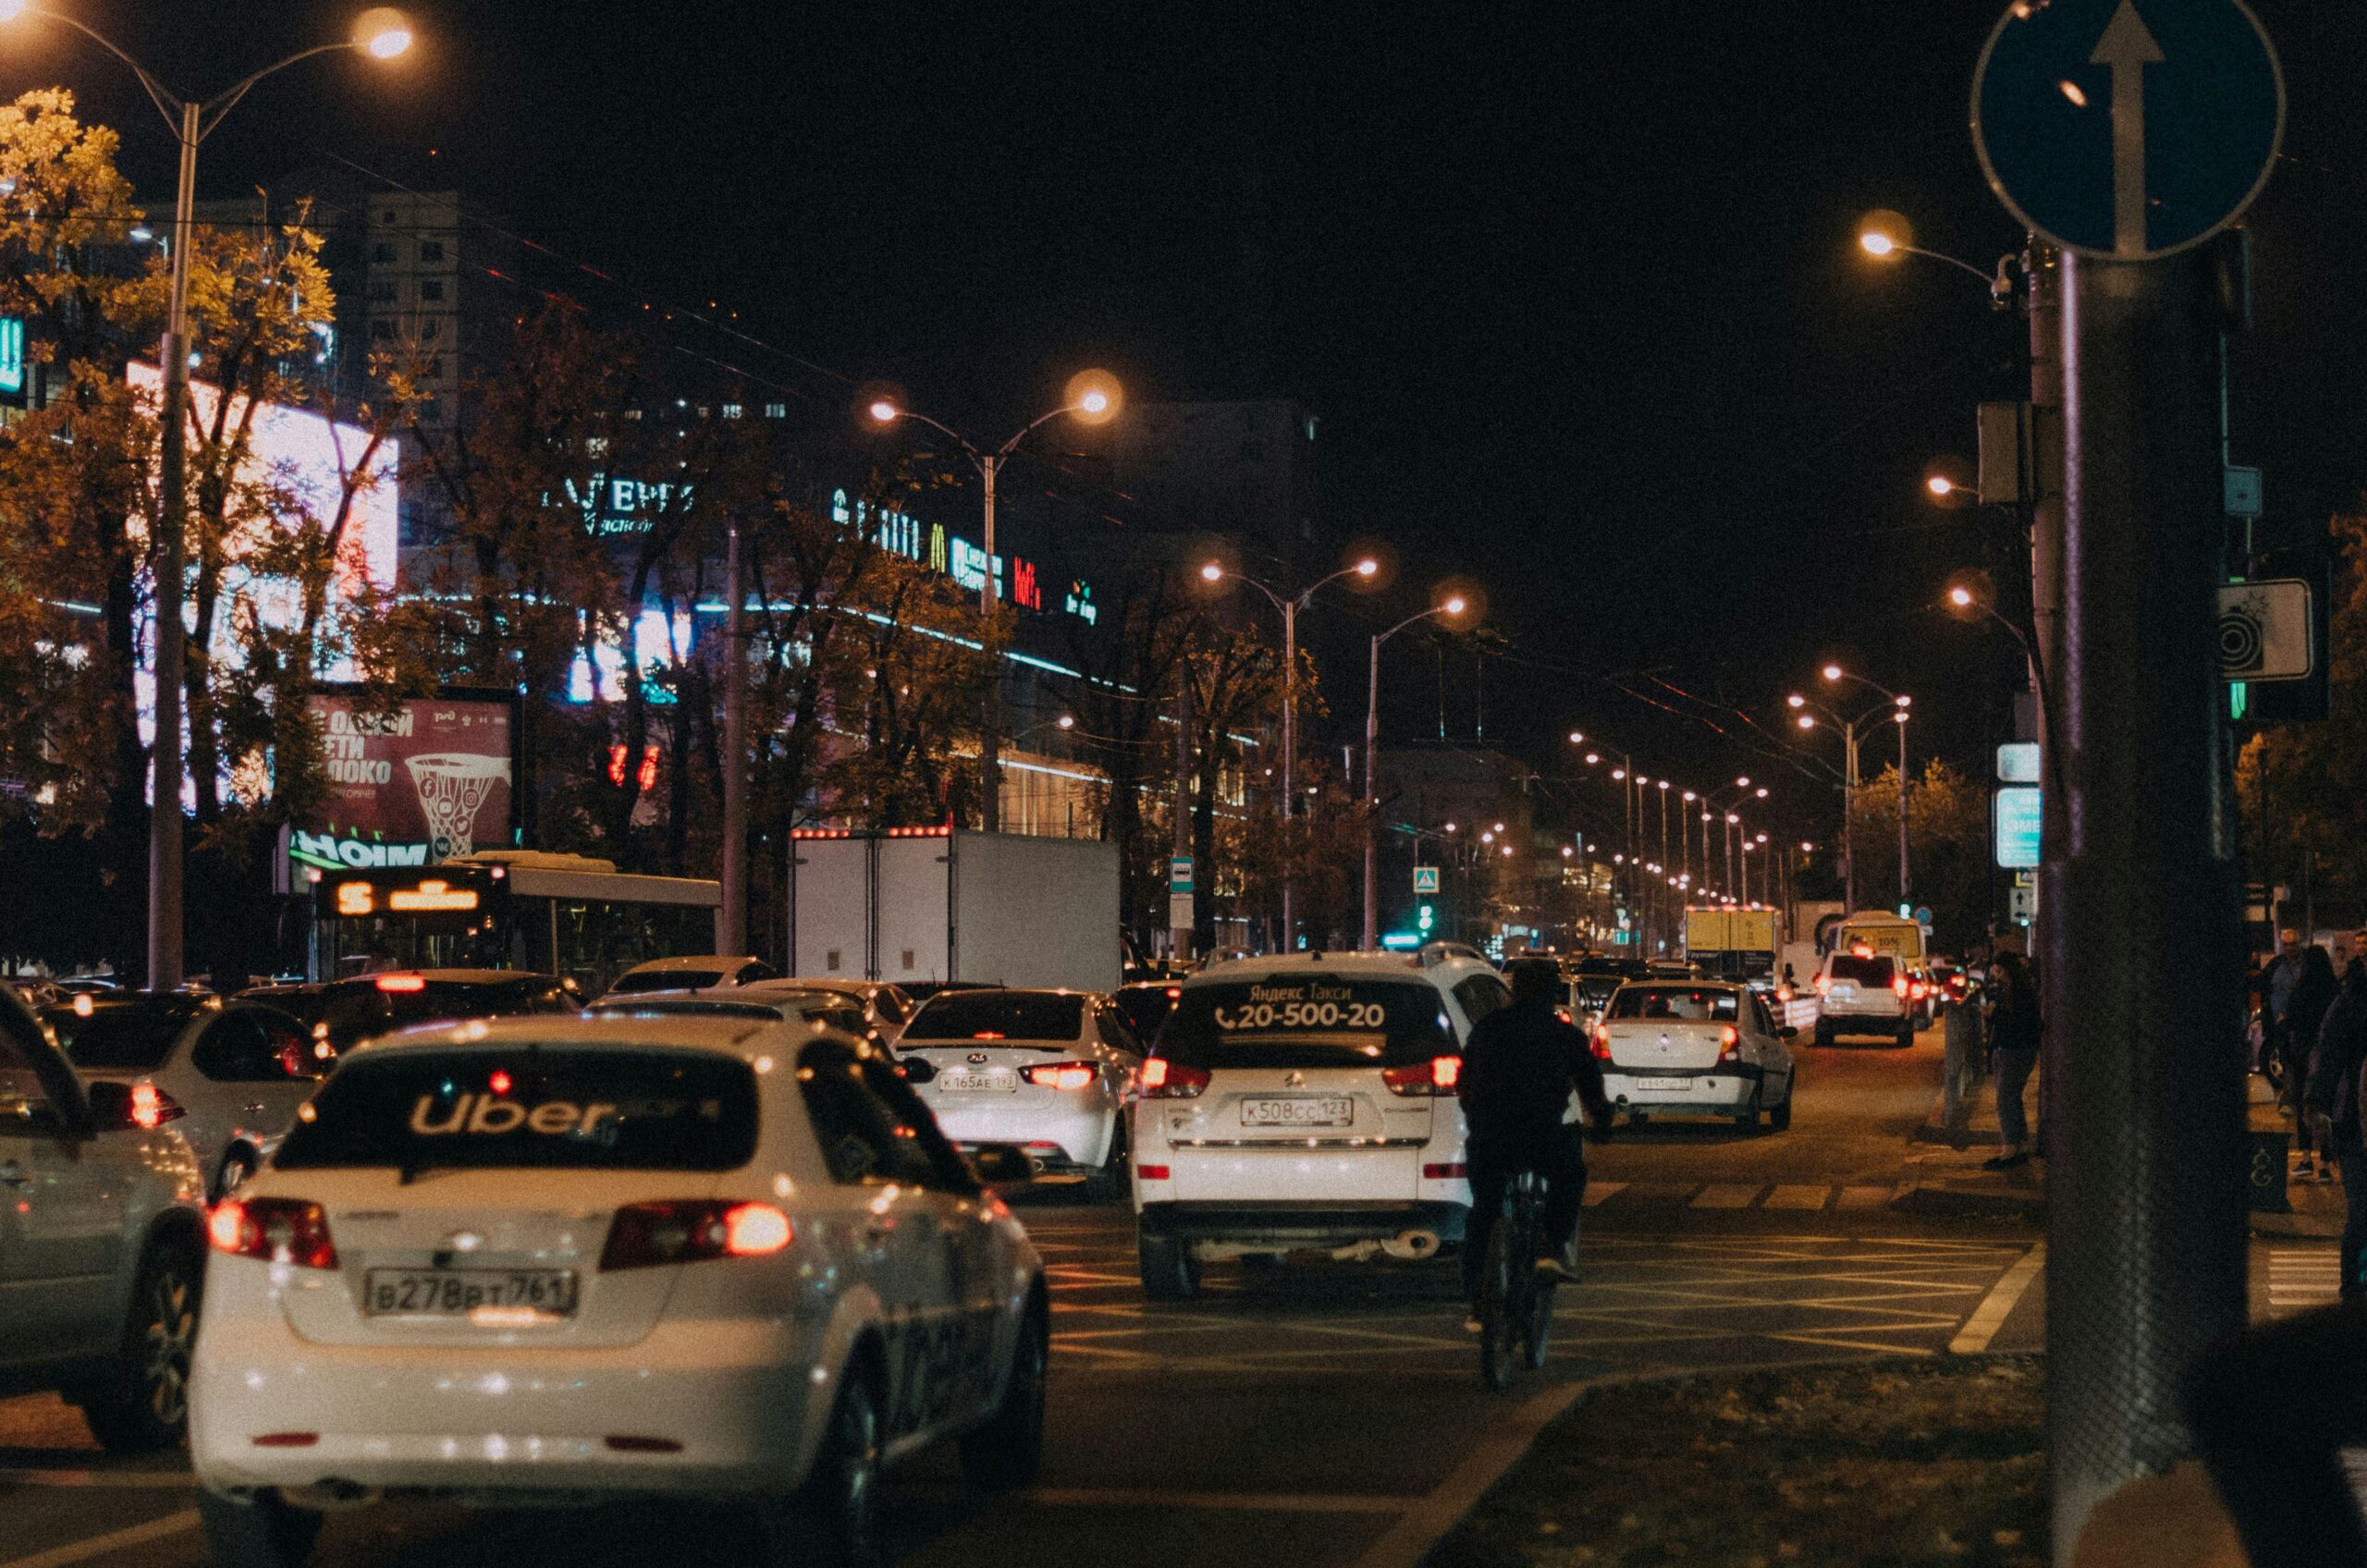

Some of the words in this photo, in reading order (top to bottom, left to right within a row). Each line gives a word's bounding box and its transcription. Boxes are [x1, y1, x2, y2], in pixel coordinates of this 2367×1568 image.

[1251, 985, 1304, 1001] Яндекс
[1311, 984, 1352, 999] Такси
[1238, 1002, 1386, 1028] 20-500-20
[409, 1093, 617, 1134] Uber
